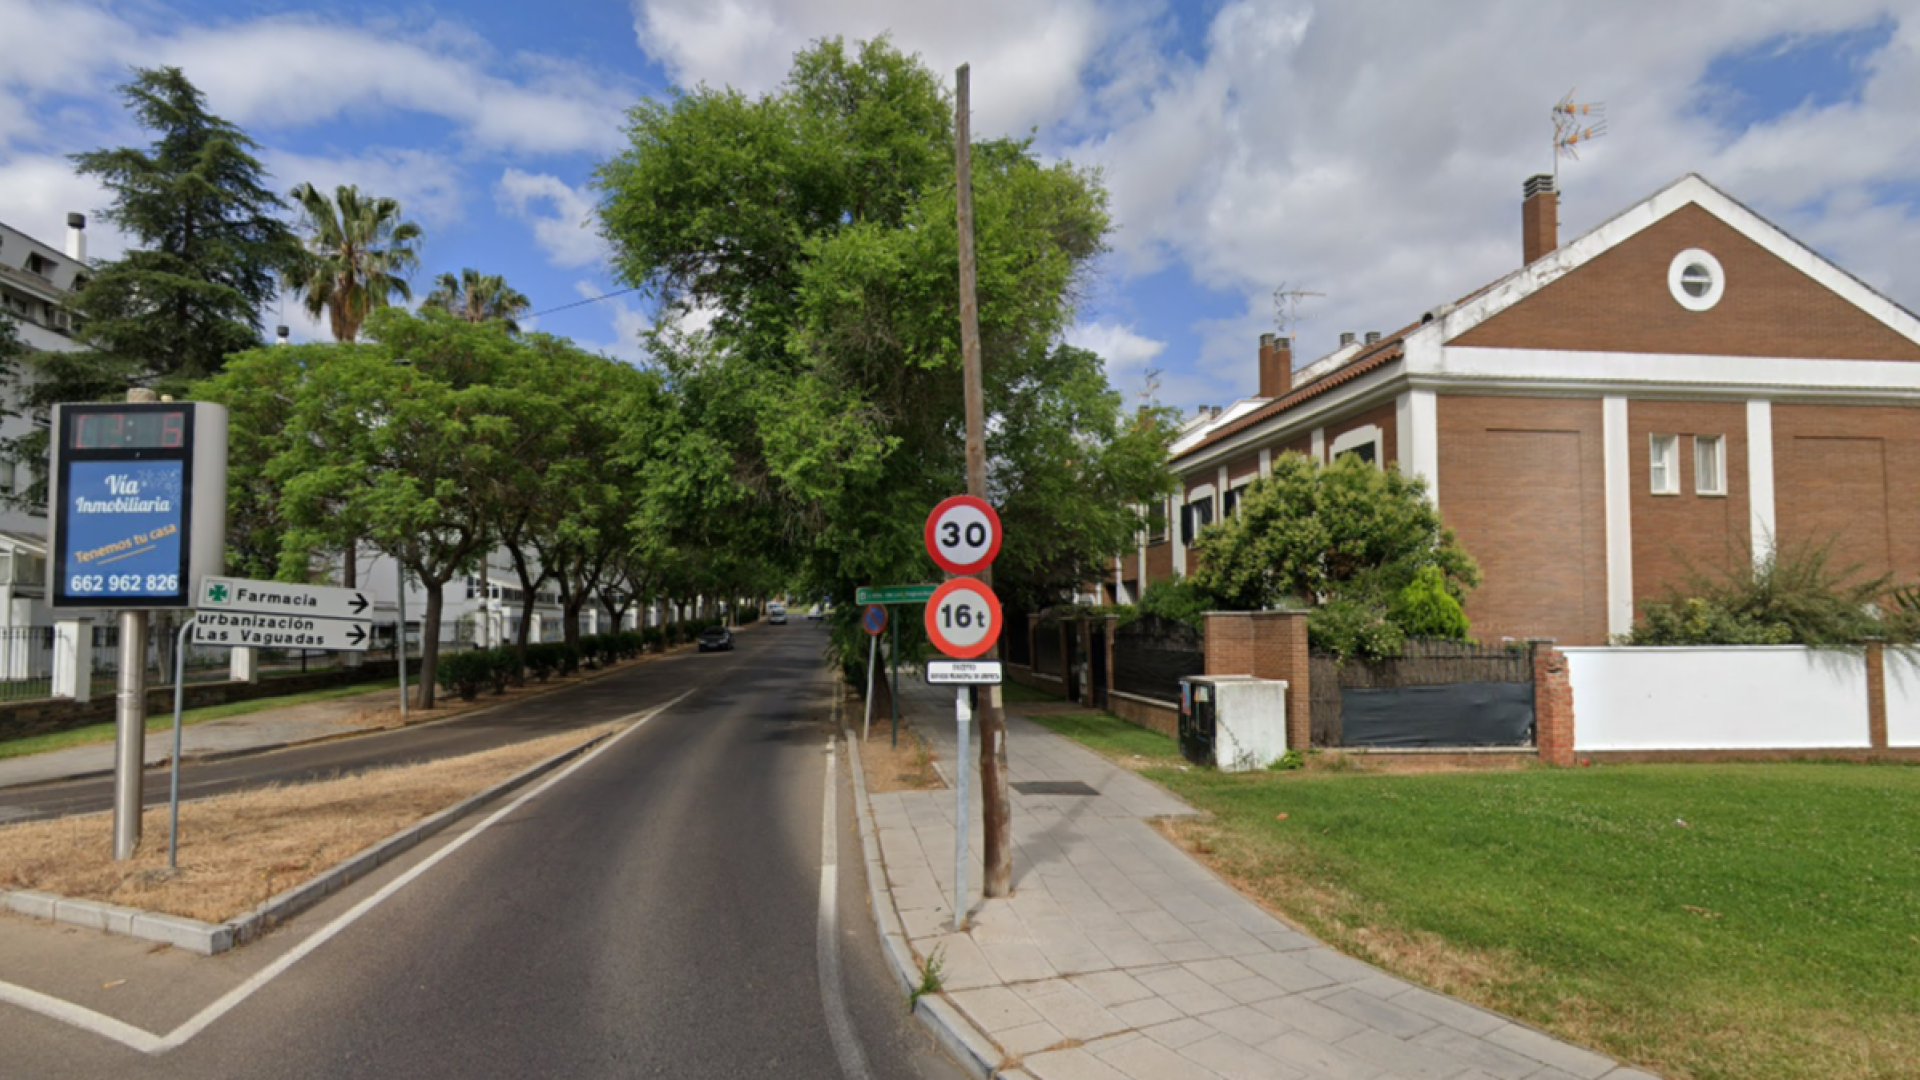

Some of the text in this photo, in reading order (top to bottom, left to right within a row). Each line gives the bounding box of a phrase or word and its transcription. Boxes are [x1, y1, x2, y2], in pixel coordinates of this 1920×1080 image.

[104, 473, 139, 495] Vía
[75, 495, 171, 514] Inmobiliaria
[74, 523, 177, 563] Tenemos tu casa
[941, 521, 986, 547] 30
[71, 573, 178, 592] 662 962 826
[237, 588, 317, 607] Farmacia
[196, 626, 325, 645] Las Vaguadas
